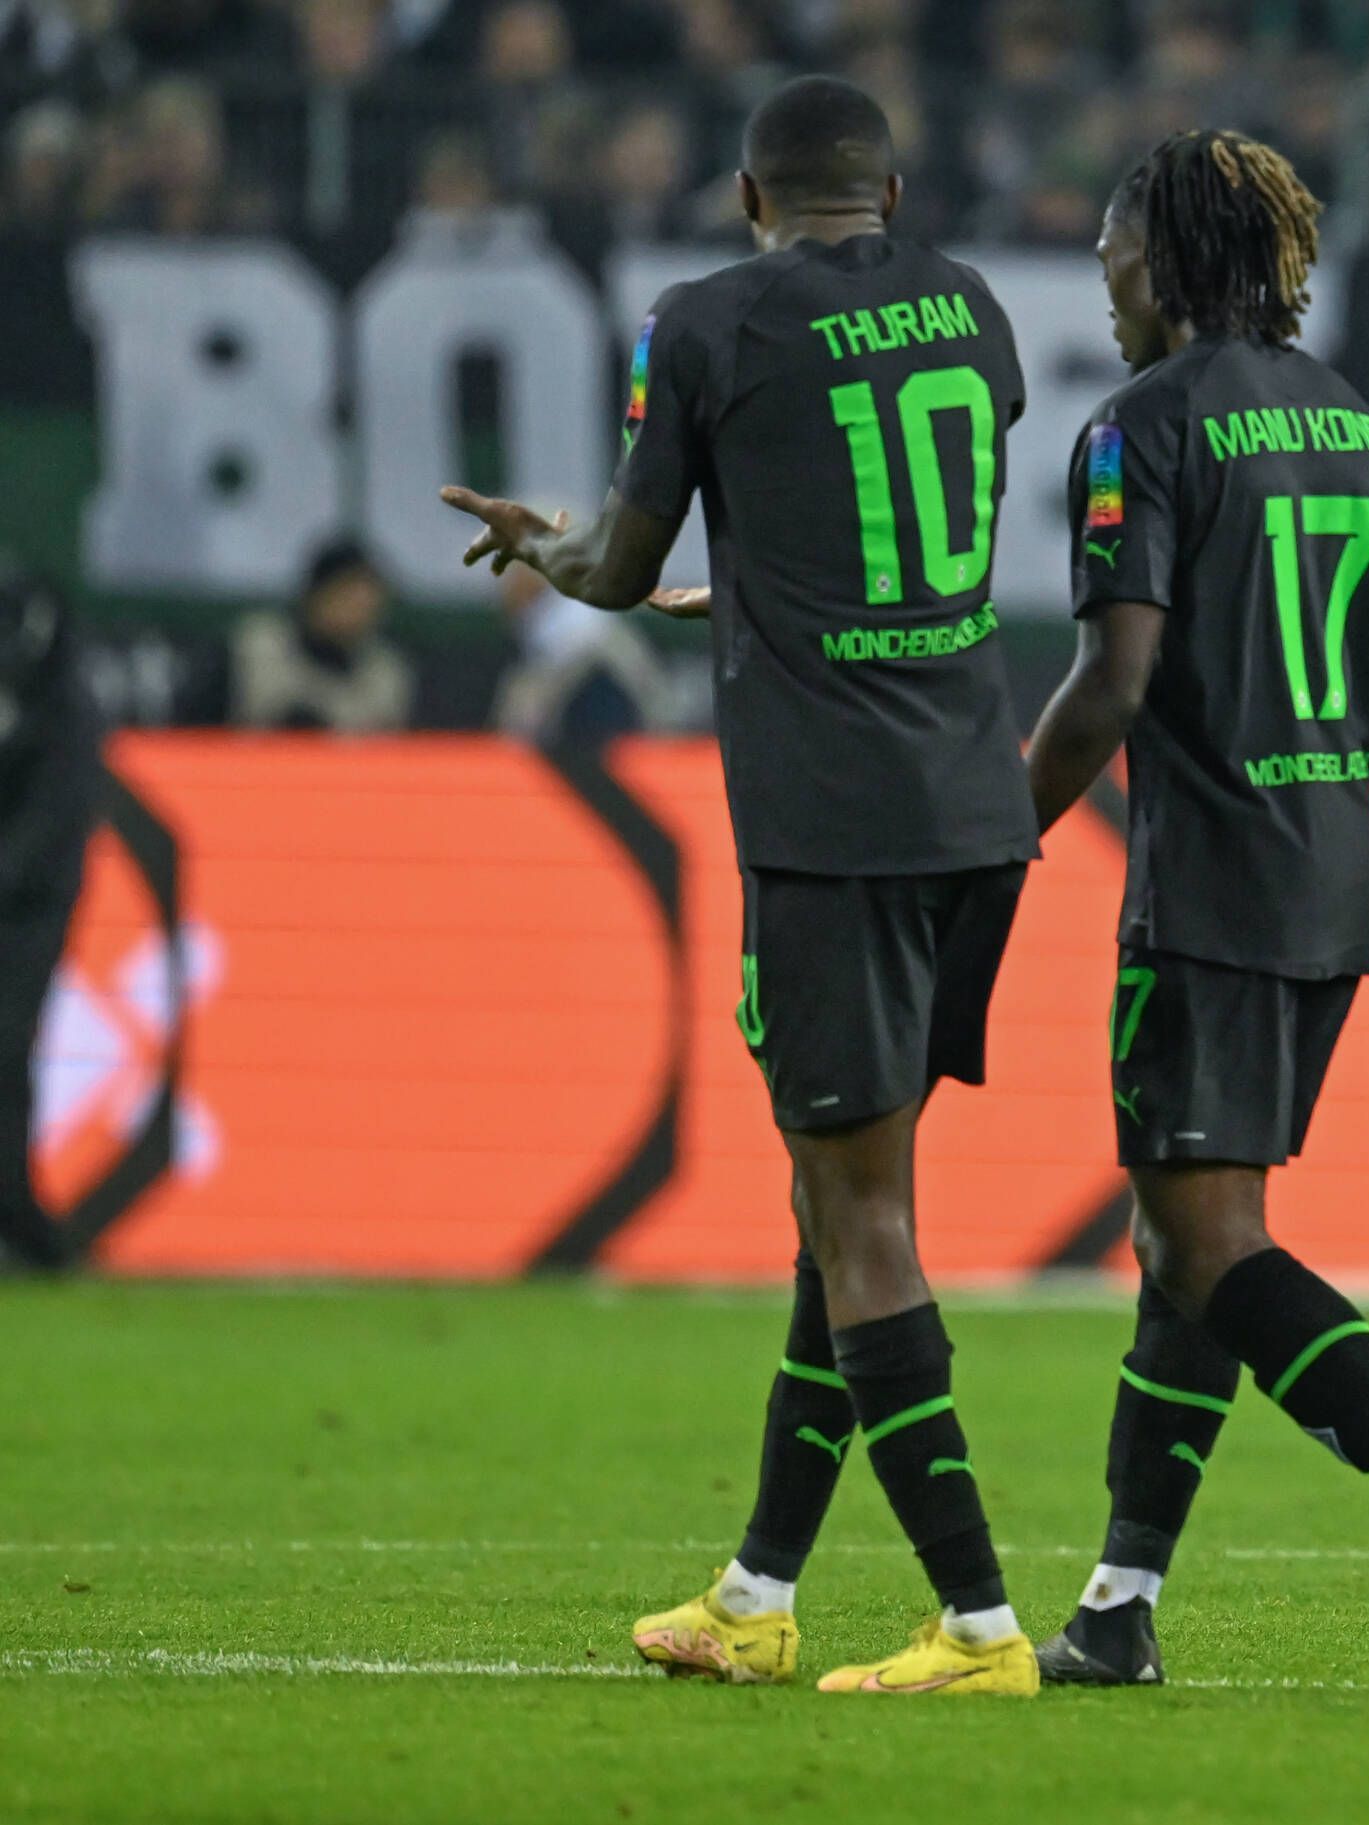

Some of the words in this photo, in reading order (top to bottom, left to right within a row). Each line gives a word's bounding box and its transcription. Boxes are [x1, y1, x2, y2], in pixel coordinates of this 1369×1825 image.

[809, 293, 980, 359] THURAM
[1203, 407, 1304, 461] MANU
[829, 366, 995, 604] 10
